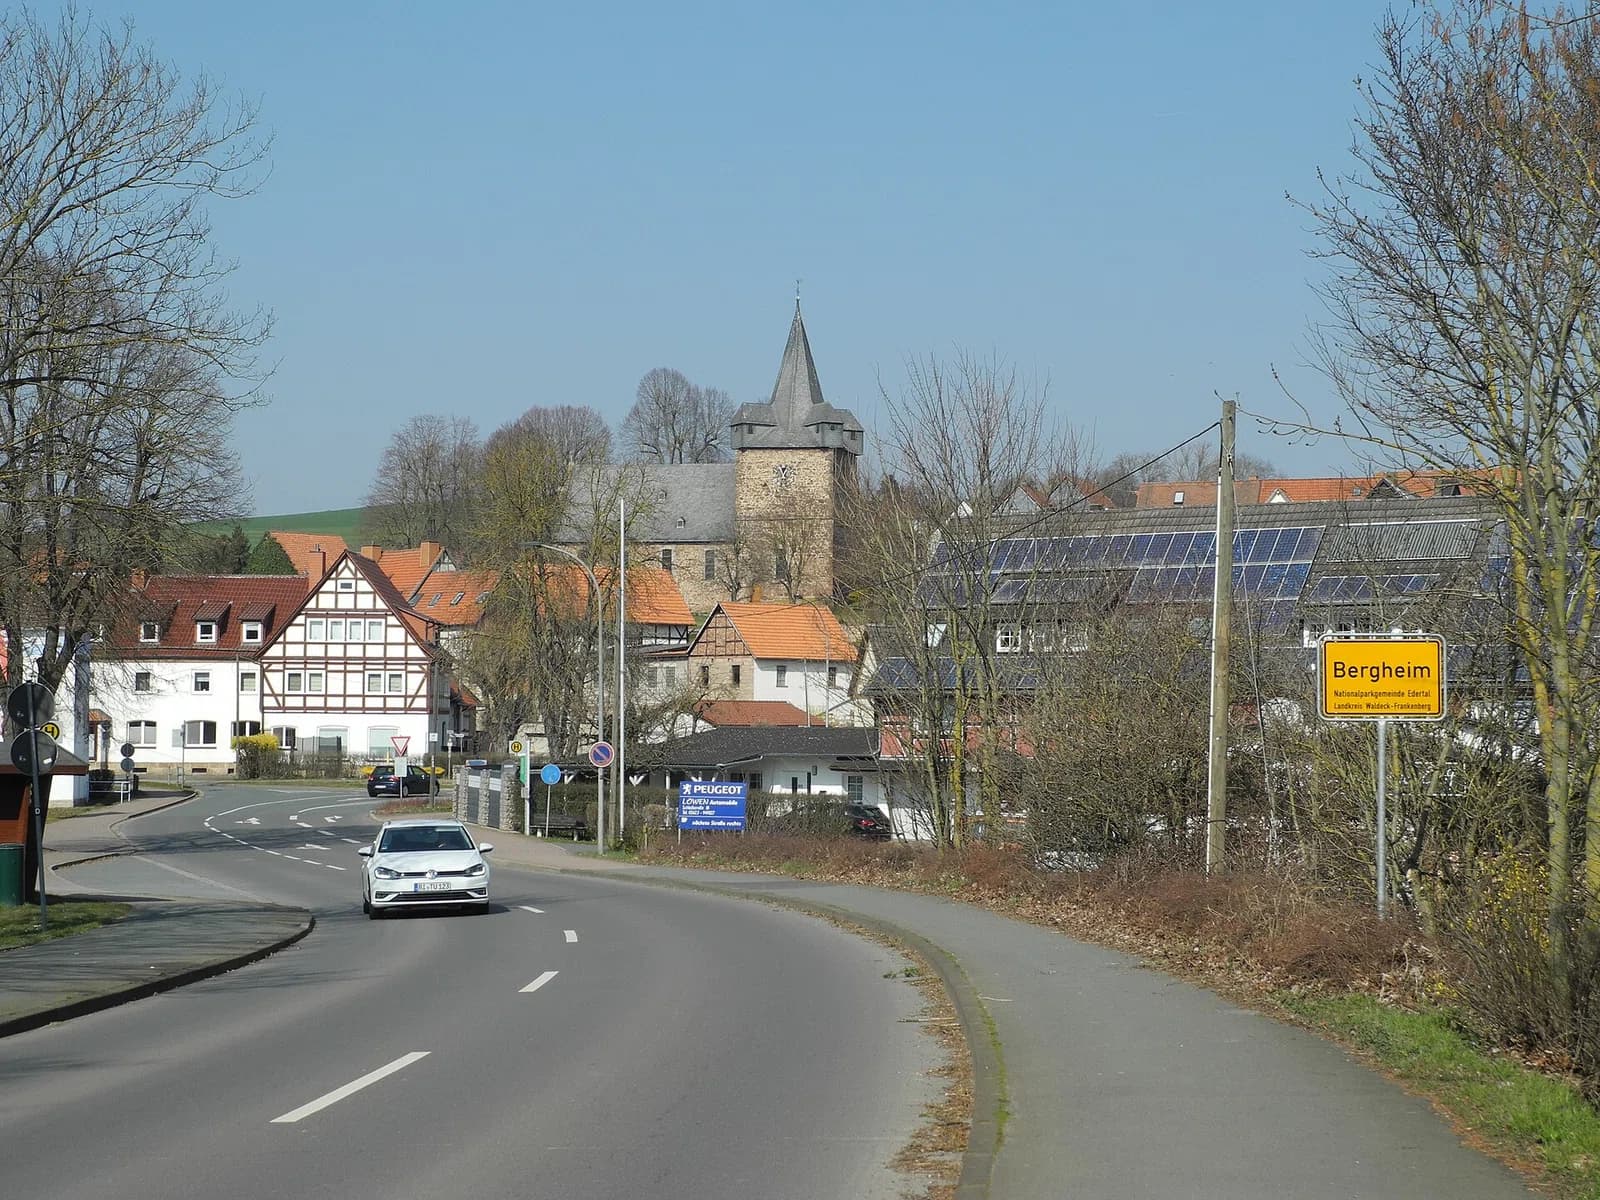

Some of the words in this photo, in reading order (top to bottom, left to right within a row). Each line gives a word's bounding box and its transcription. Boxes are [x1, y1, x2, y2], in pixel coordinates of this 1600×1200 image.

[1333, 661, 1431, 683] Bergheim
[1333, 690, 1405, 699] Nationalparkgemeinde
[1407, 690, 1431, 698] Edertal
[1333, 702, 1363, 710] Landkreis
[1365, 702, 1432, 711] Waldeck-Frankenberg
[693, 785, 743, 795] PEUGEOT
